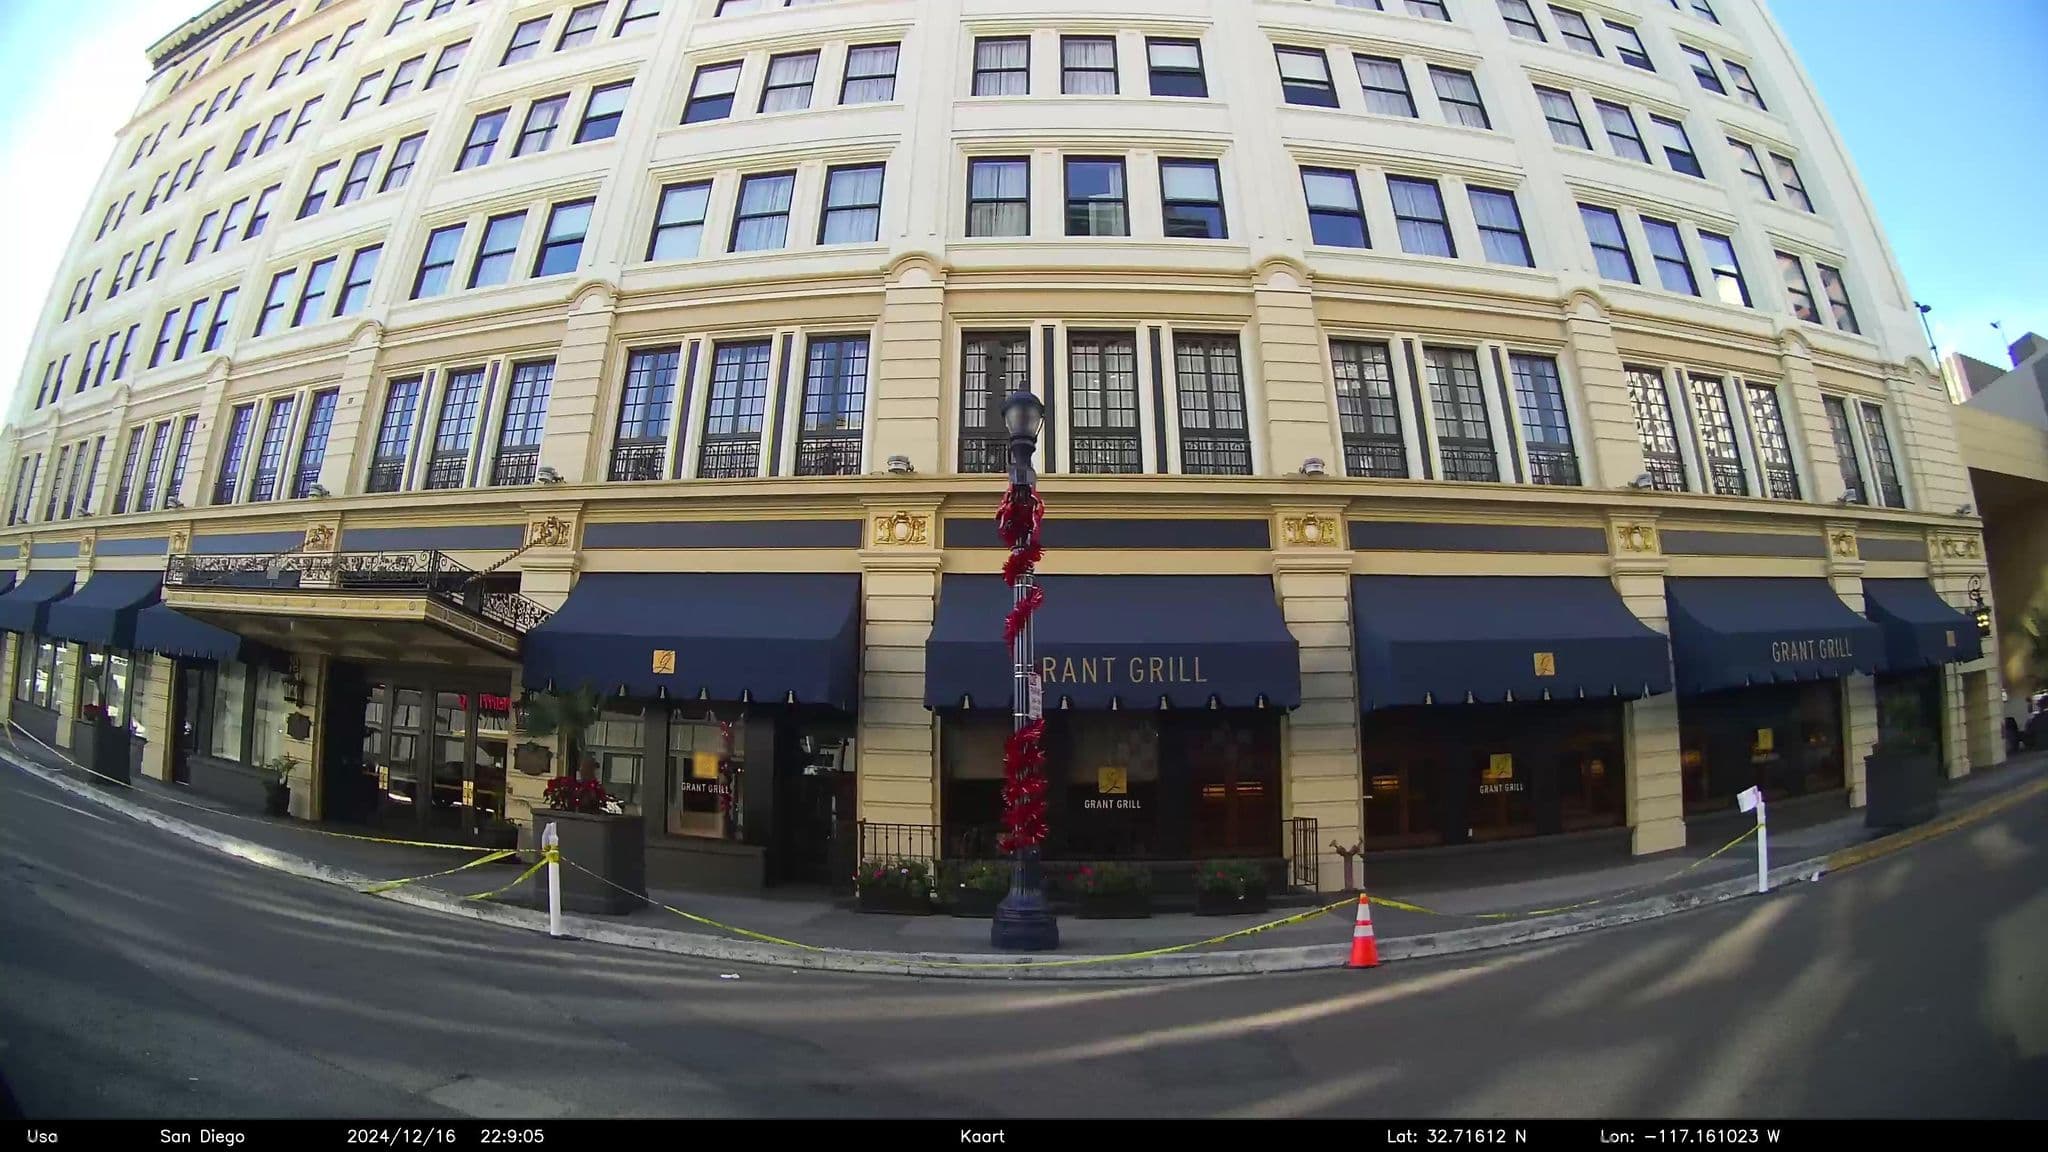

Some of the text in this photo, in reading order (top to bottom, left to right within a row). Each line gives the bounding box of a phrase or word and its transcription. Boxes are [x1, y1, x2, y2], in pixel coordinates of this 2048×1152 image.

[1772, 637, 1853, 663] GRANT GRILL
[1042, 656, 1208, 683] RANT GRILL
[681, 782, 730, 794] GRANT GRILL
[1480, 783, 1524, 793] GRANT GRILL
[1084, 799, 1142, 809] GRANT GRILL
